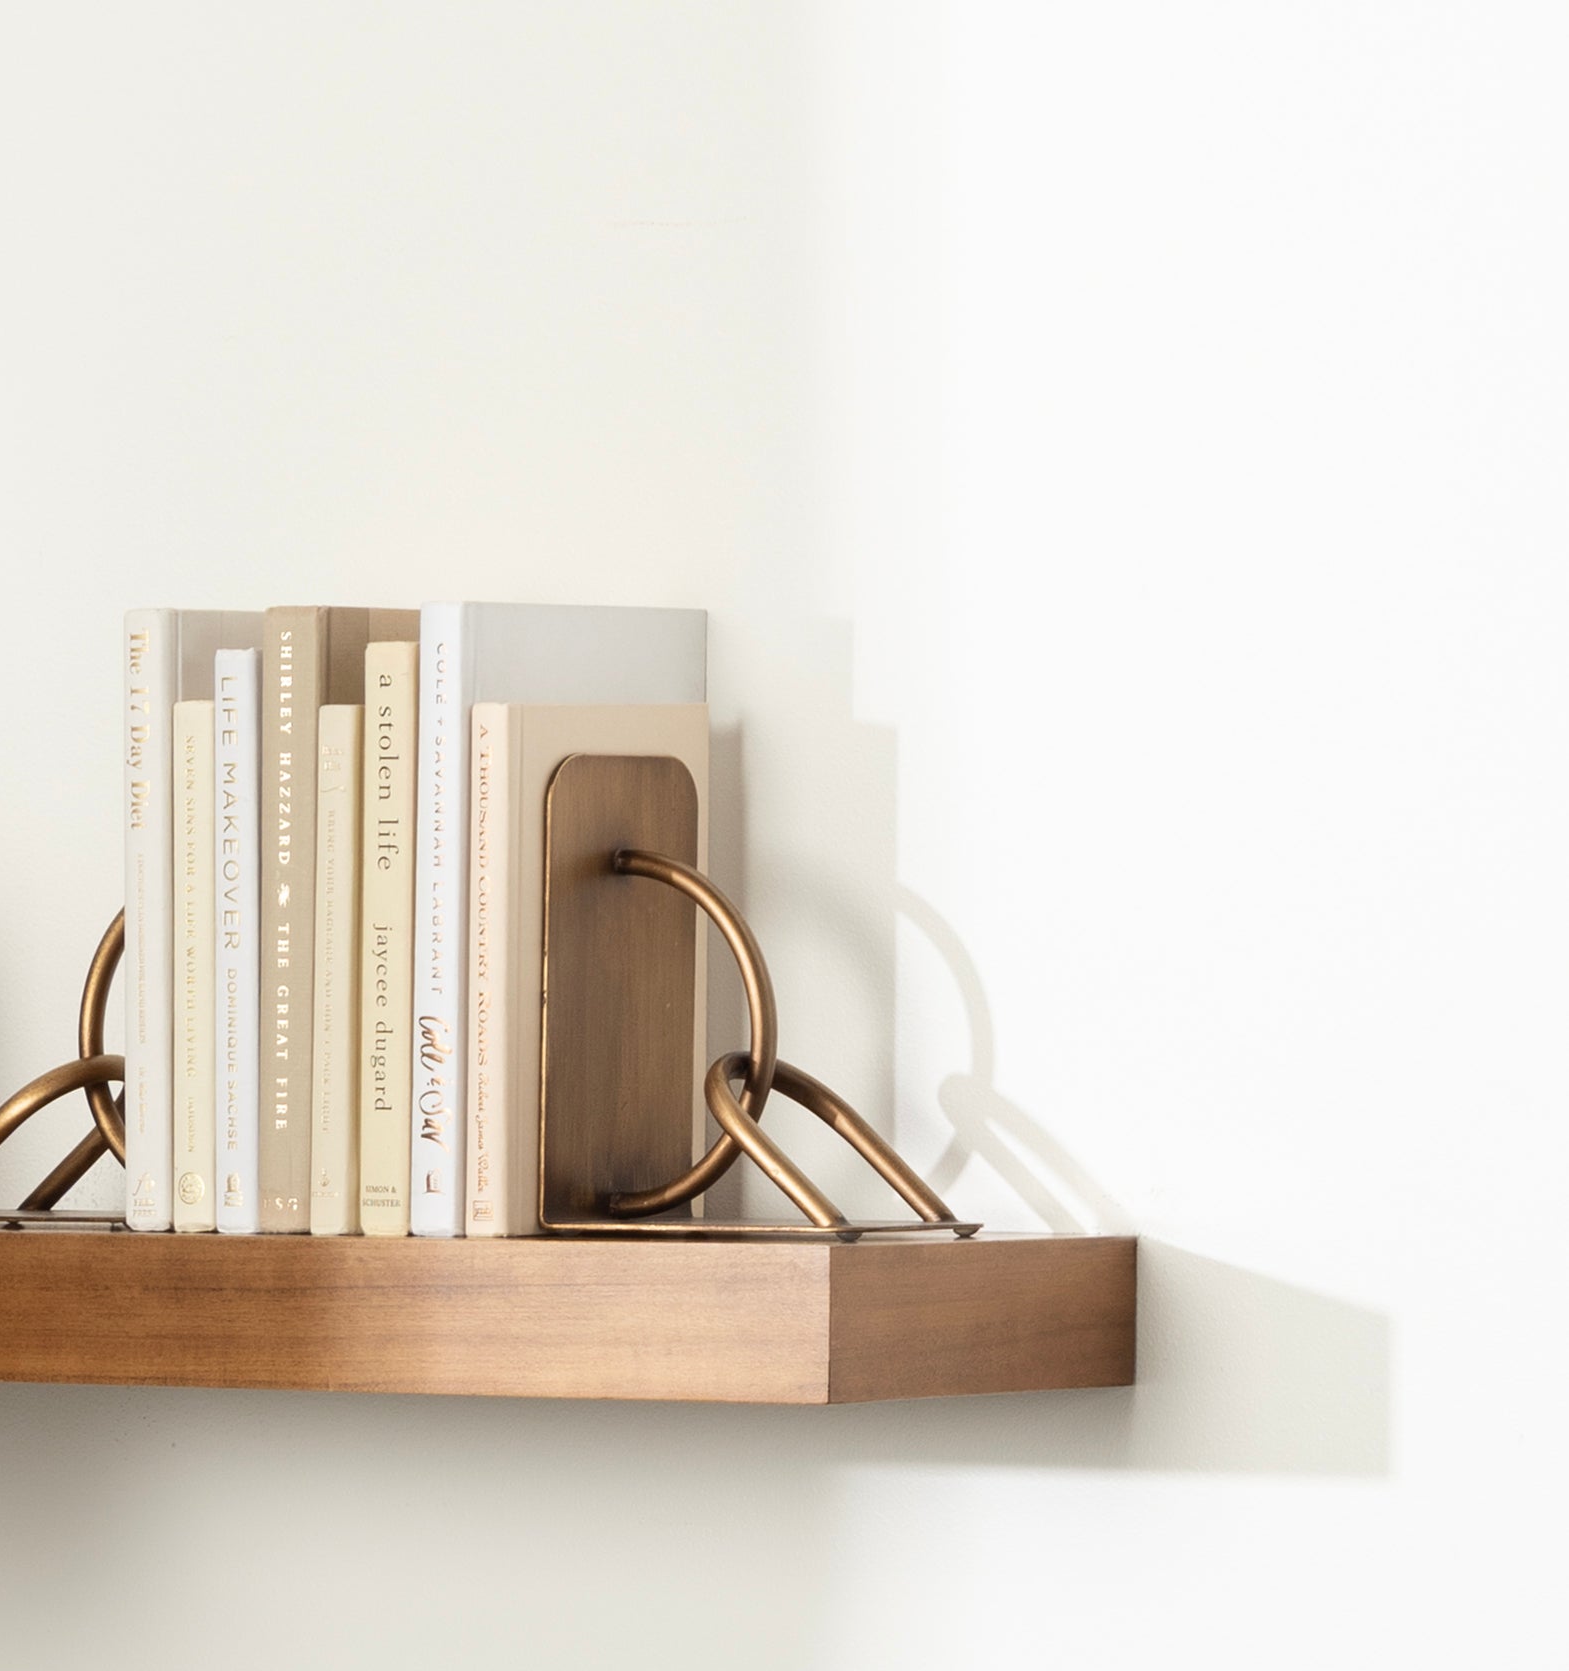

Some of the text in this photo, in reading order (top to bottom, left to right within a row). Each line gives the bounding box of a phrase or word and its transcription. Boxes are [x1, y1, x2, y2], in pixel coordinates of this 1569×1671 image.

[126, 629, 150, 831] The 17 Day Diet
[278, 631, 292, 866] SHIRLEY HAZZARD
[436, 642, 448, 706] COLE
[221, 676, 240, 950] LIFE MAKEOVER
[377, 674, 399, 872] a stolen life
[432, 736, 447, 868] SAVANNAH
[185, 735, 196, 1078] SEVEN SINS FOR A LIFE WORTH LIVING
[431, 882, 446, 996] LABRANT
[478, 724, 493, 1067] A THOUSAND COUNTRY ROADS
[226, 968, 238, 1150] DOMINIQUE SACHSE
[275, 922, 290, 1130] THE GREAT FIRE
[370, 923, 393, 1112] jaycee dugard
[418, 1015, 453, 1072] Cole
[362, 1199, 401, 1208] SCHUSTER
[365, 1185, 388, 1194] SIMON
[418, 1090, 453, 1154] Sav
[475, 1114, 490, 1150] James
